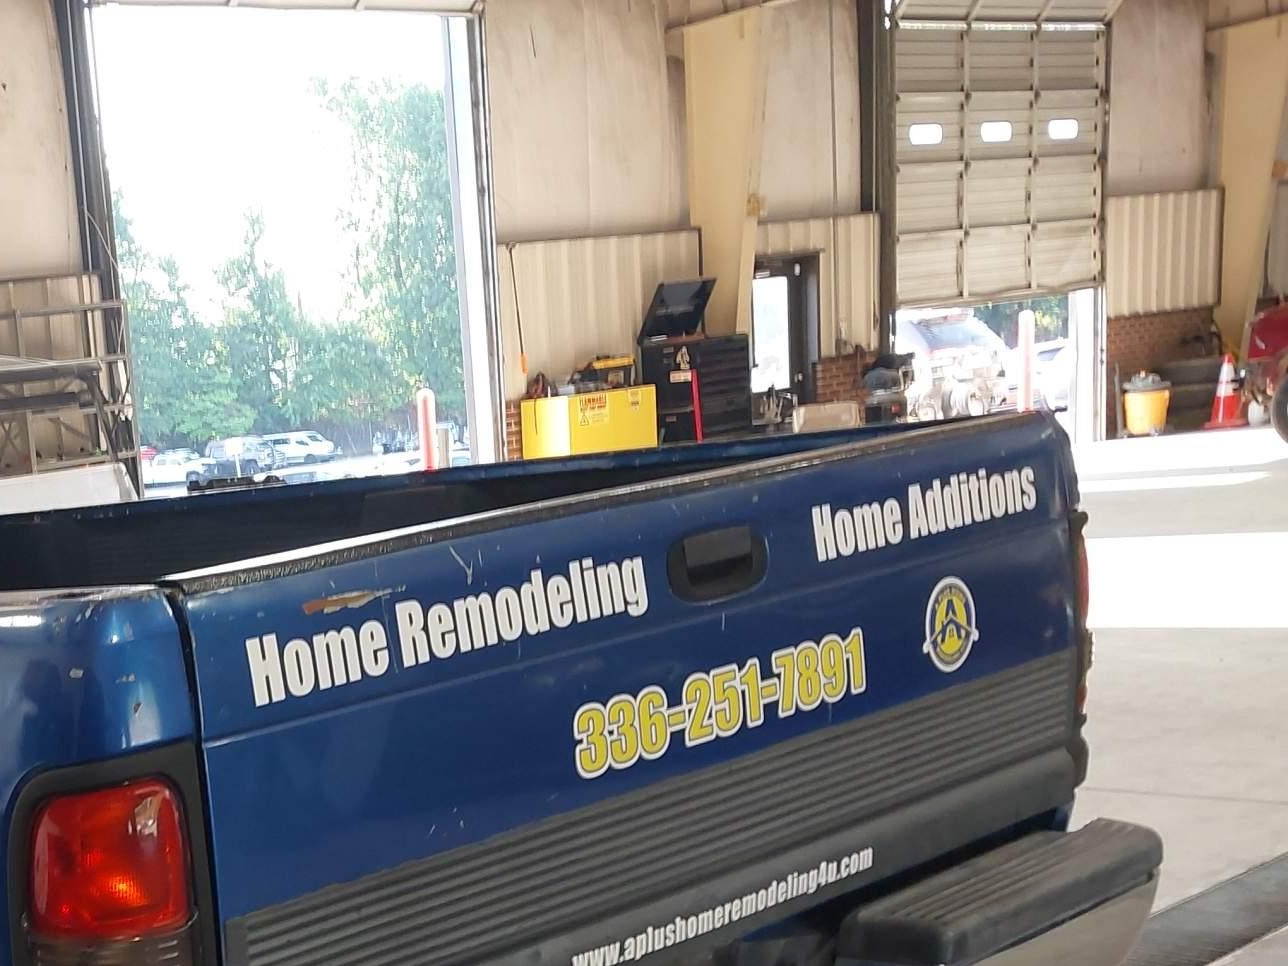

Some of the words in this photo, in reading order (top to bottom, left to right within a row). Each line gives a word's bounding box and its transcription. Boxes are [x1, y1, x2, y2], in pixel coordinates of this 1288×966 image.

[811, 497, 904, 562] Home
[908, 466, 1037, 539] Additions
[245, 619, 391, 708] Home
[395, 555, 649, 668] Remodeling
[573, 627, 867, 780] 336-251-7891
